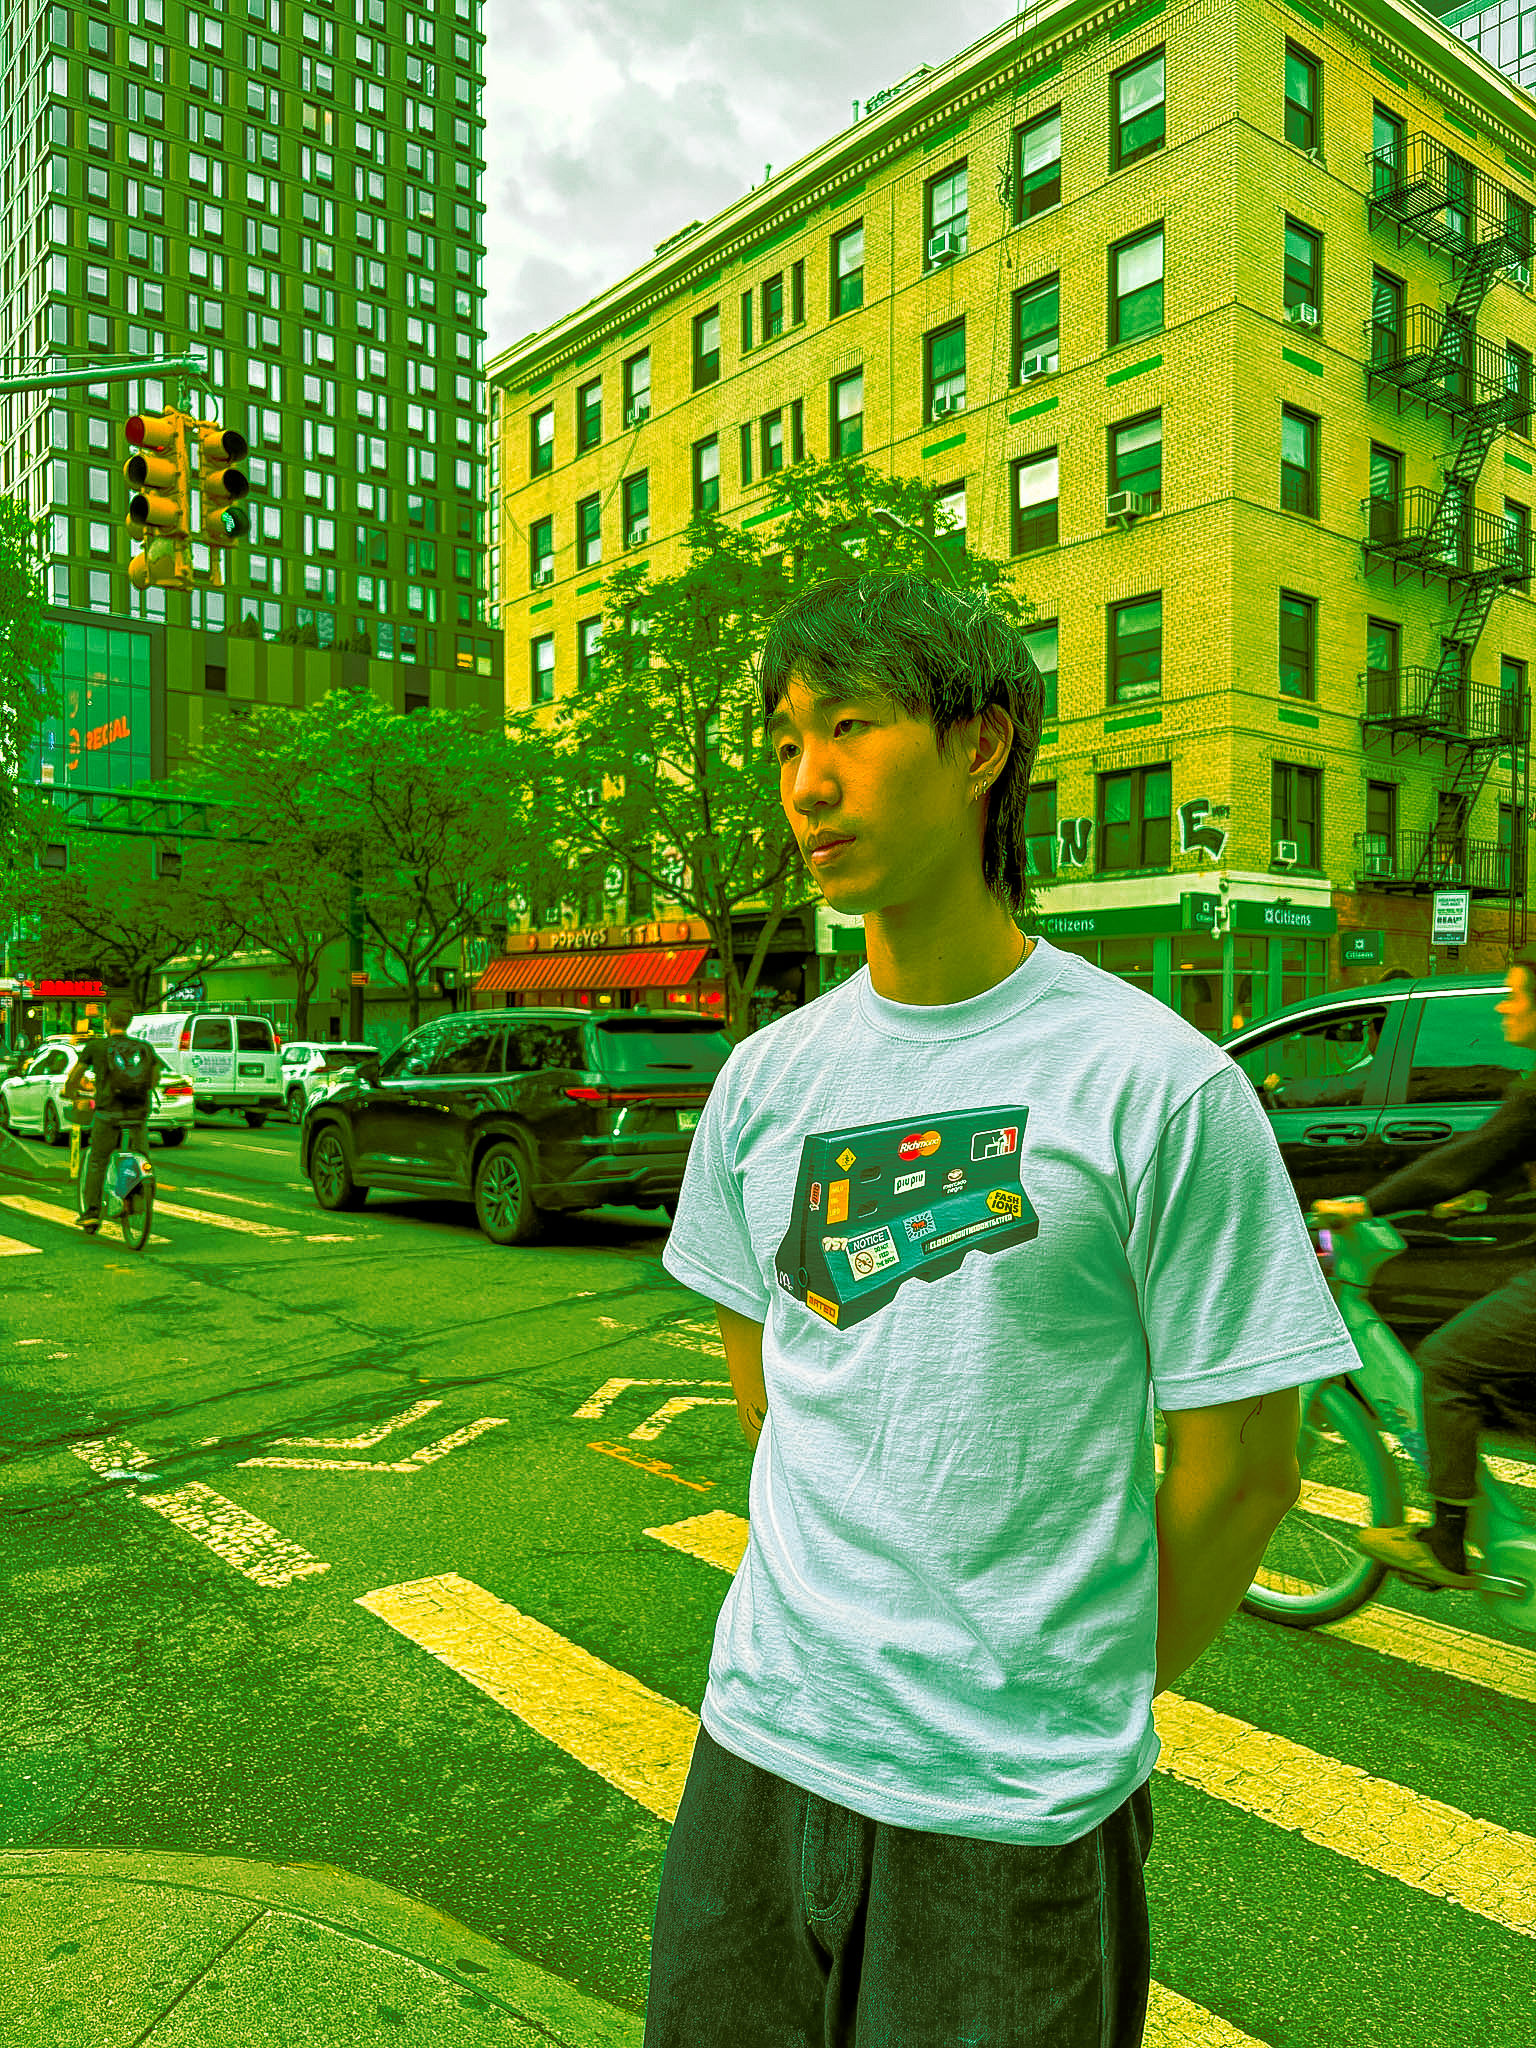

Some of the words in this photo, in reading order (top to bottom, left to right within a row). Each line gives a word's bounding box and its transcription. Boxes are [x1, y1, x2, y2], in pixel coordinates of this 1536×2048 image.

[1046, 917, 1096, 934] Citizens
[1273, 908, 1312, 927] Citizens
[550, 927, 608, 949] POPEYES
[1345, 950, 1375, 960] Citizens
[900, 1135, 941, 1153] Richmond
[991, 1199, 1019, 1214] IONS
[994, 1191, 1019, 1205] FASH
[853, 1231, 885, 1251] NOTICE
